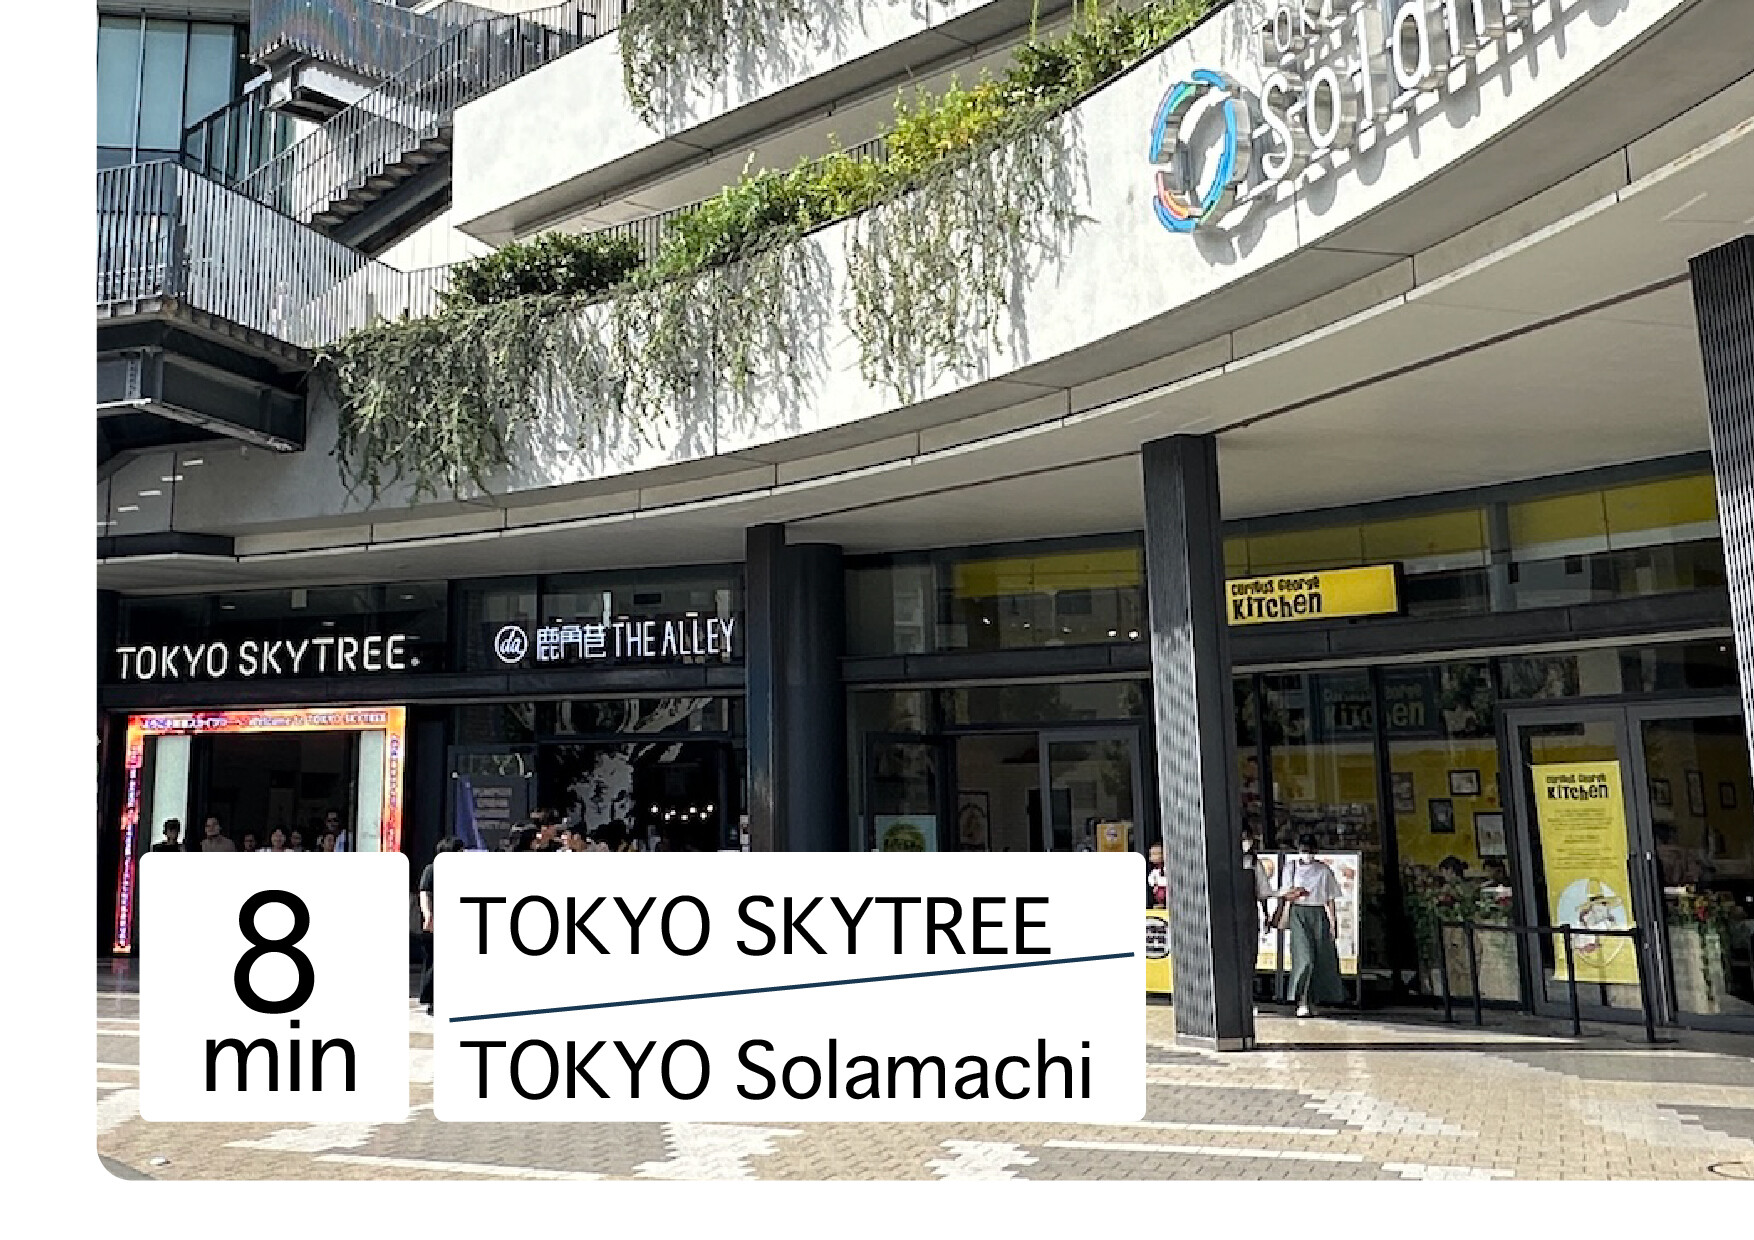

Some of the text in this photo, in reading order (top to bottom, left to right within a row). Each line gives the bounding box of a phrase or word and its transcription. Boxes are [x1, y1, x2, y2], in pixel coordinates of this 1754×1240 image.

[612, 618, 735, 657] THE ALLEY
[116, 642, 229, 679] TOKYO
